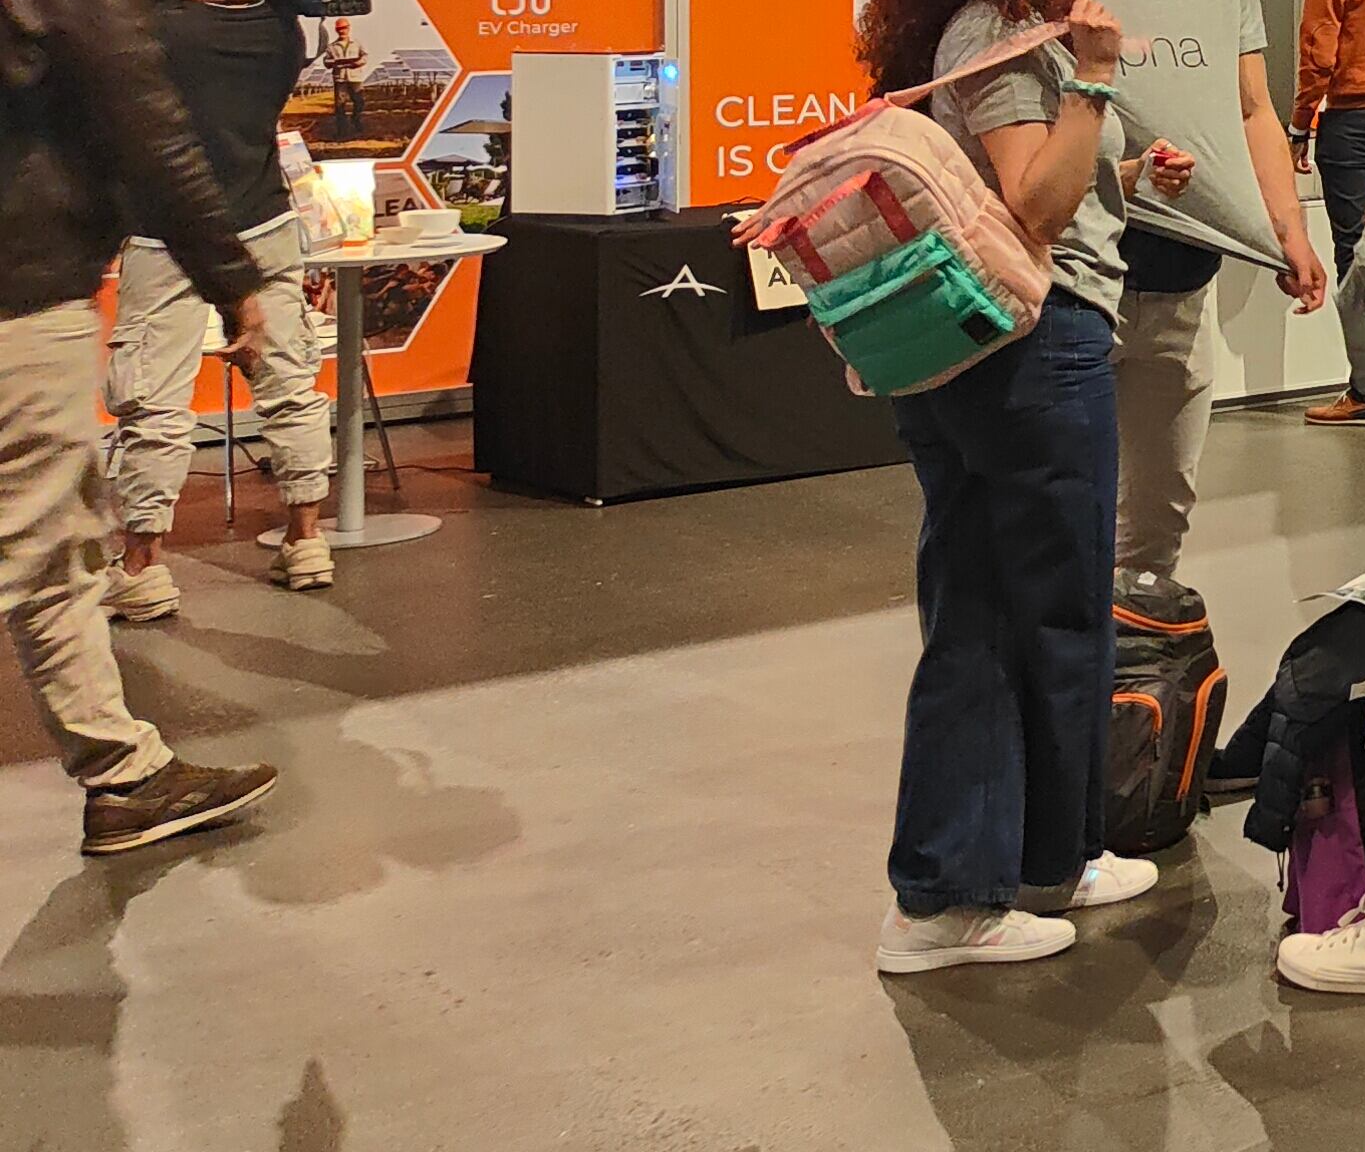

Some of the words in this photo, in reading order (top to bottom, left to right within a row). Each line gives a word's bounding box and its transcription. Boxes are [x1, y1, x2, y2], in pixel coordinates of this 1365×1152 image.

[478, 21, 503, 35] EV
[507, 20, 578, 37] Charger
[1119, 37, 1208, 77] pna
[715, 92, 856, 128] CLEAN
[717, 145, 754, 178] IS
